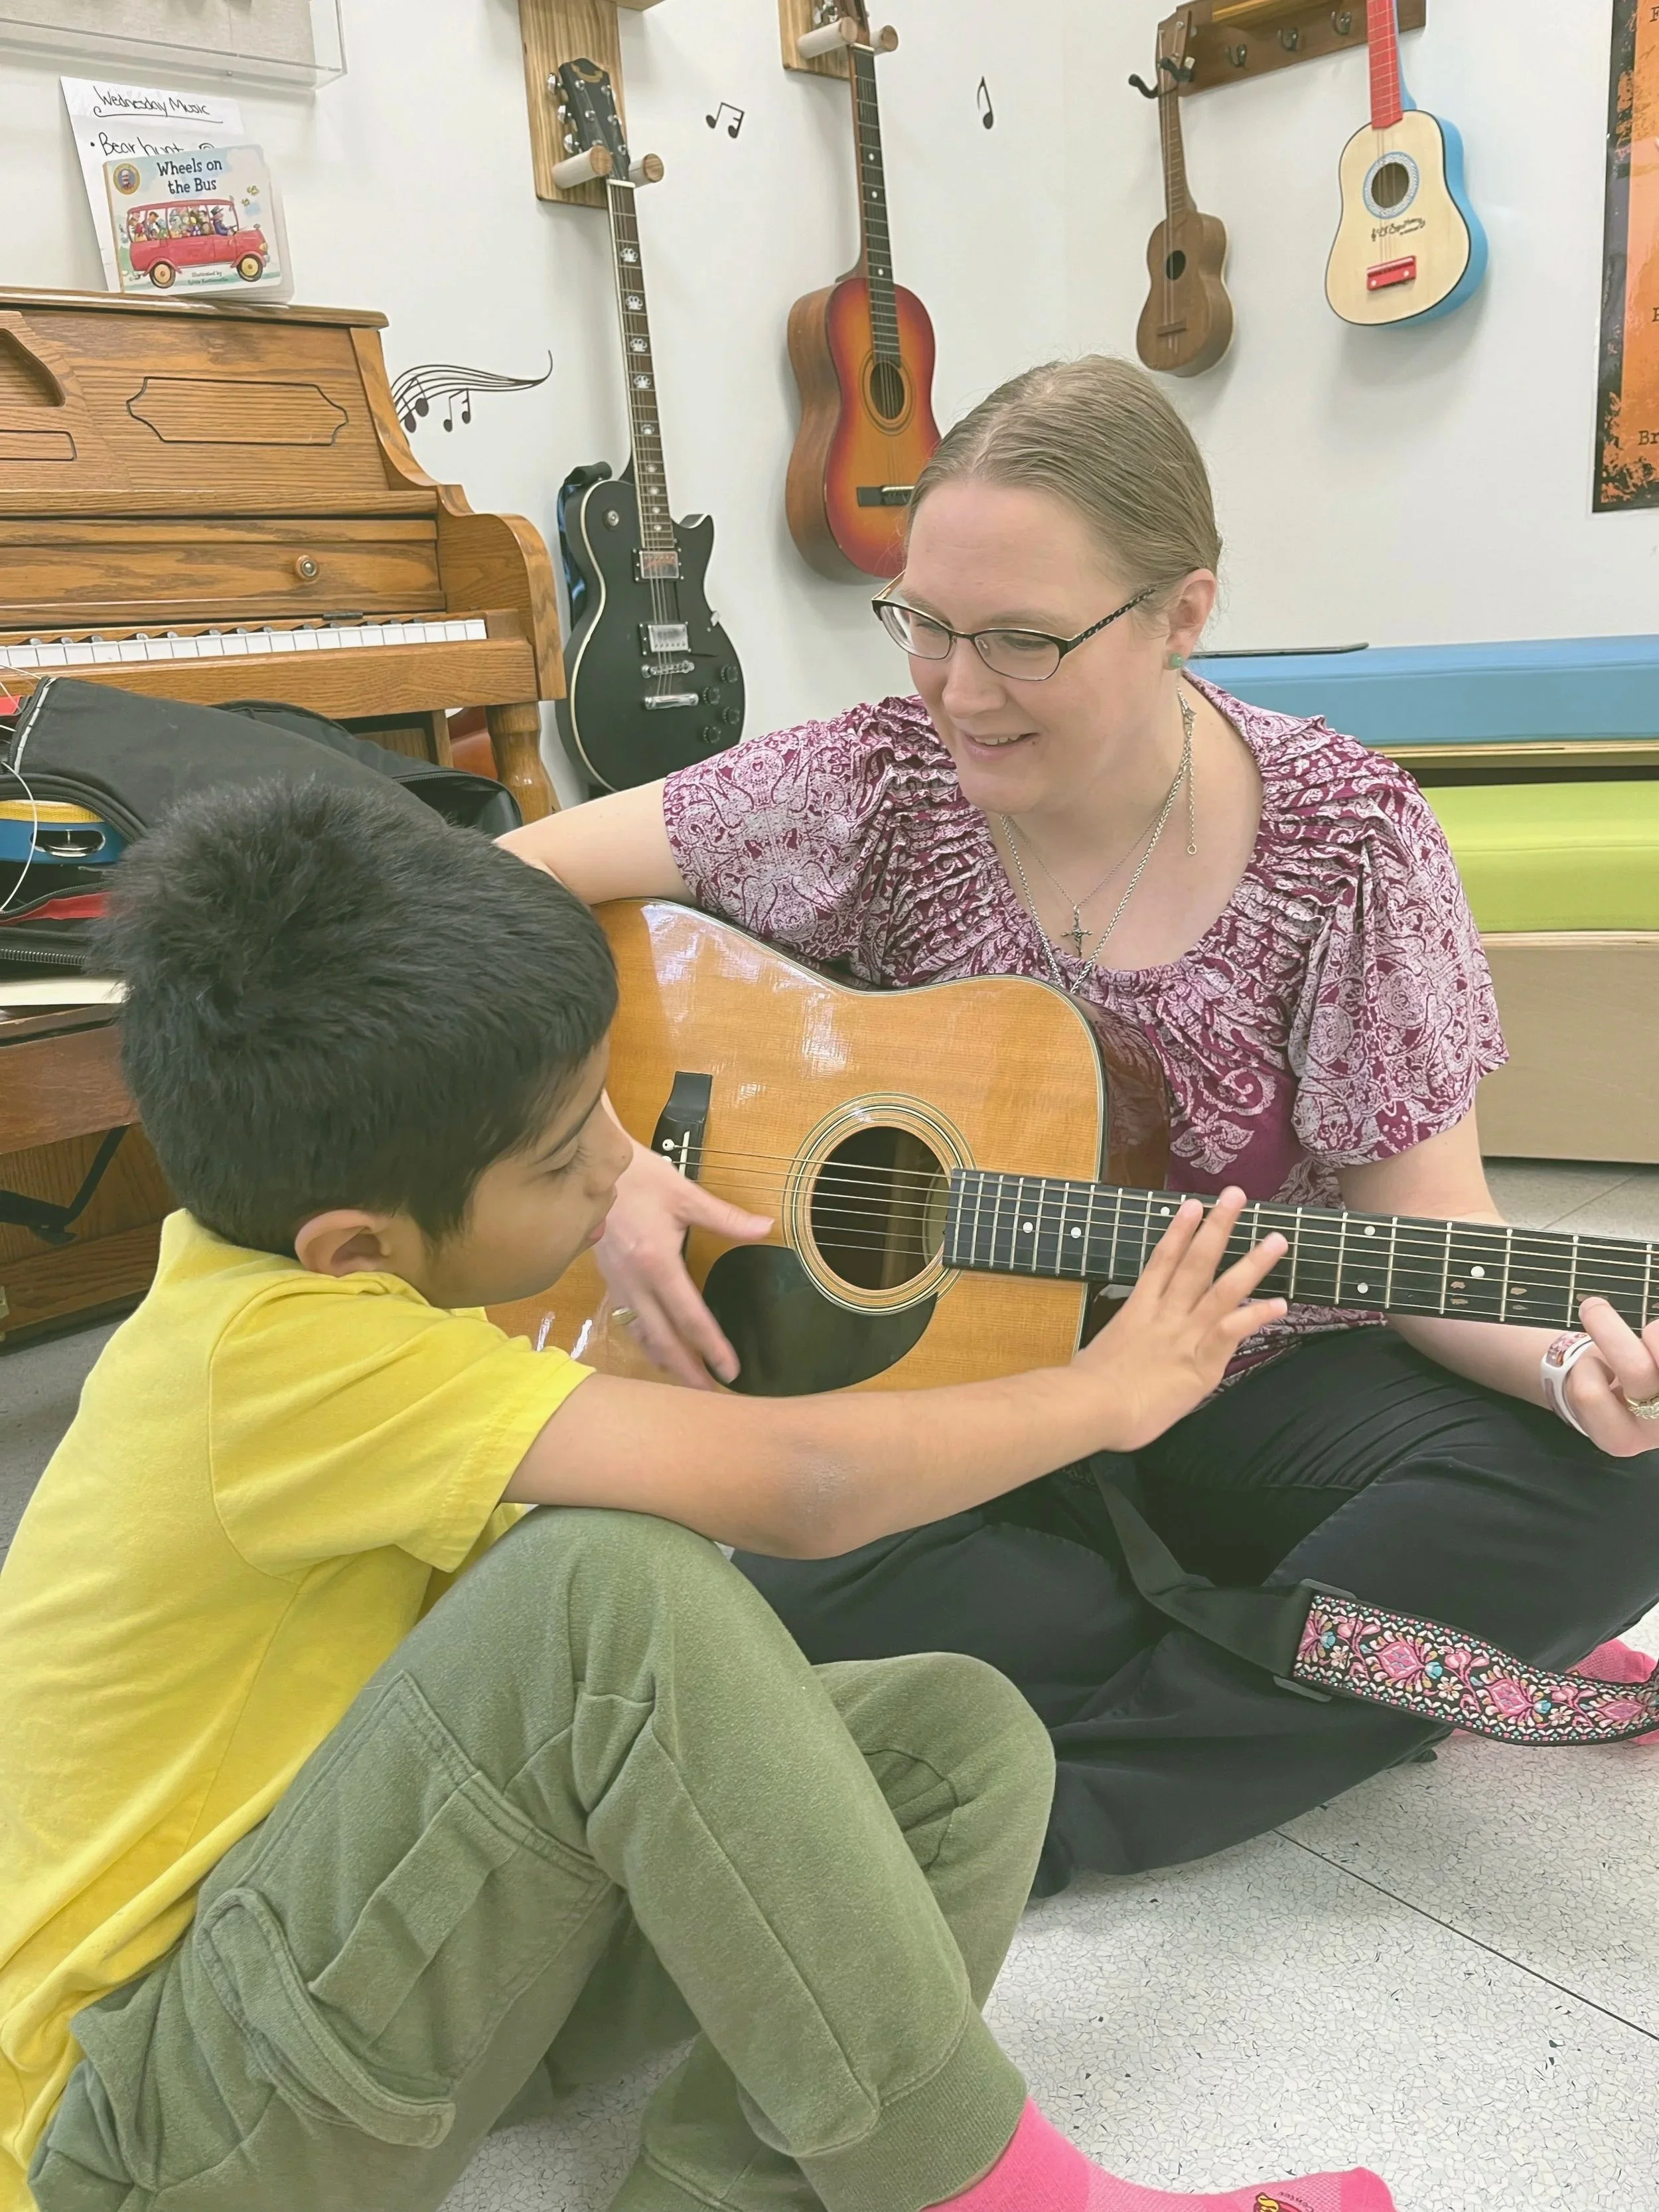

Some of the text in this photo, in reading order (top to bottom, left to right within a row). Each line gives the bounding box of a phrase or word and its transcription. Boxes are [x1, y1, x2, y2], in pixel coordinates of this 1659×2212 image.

[93, 85, 210, 117] Wednesday Music
[98, 131, 136, 157] Bear
[157, 158, 223, 177] Wheels on
[168, 178, 217, 194] the Bus
